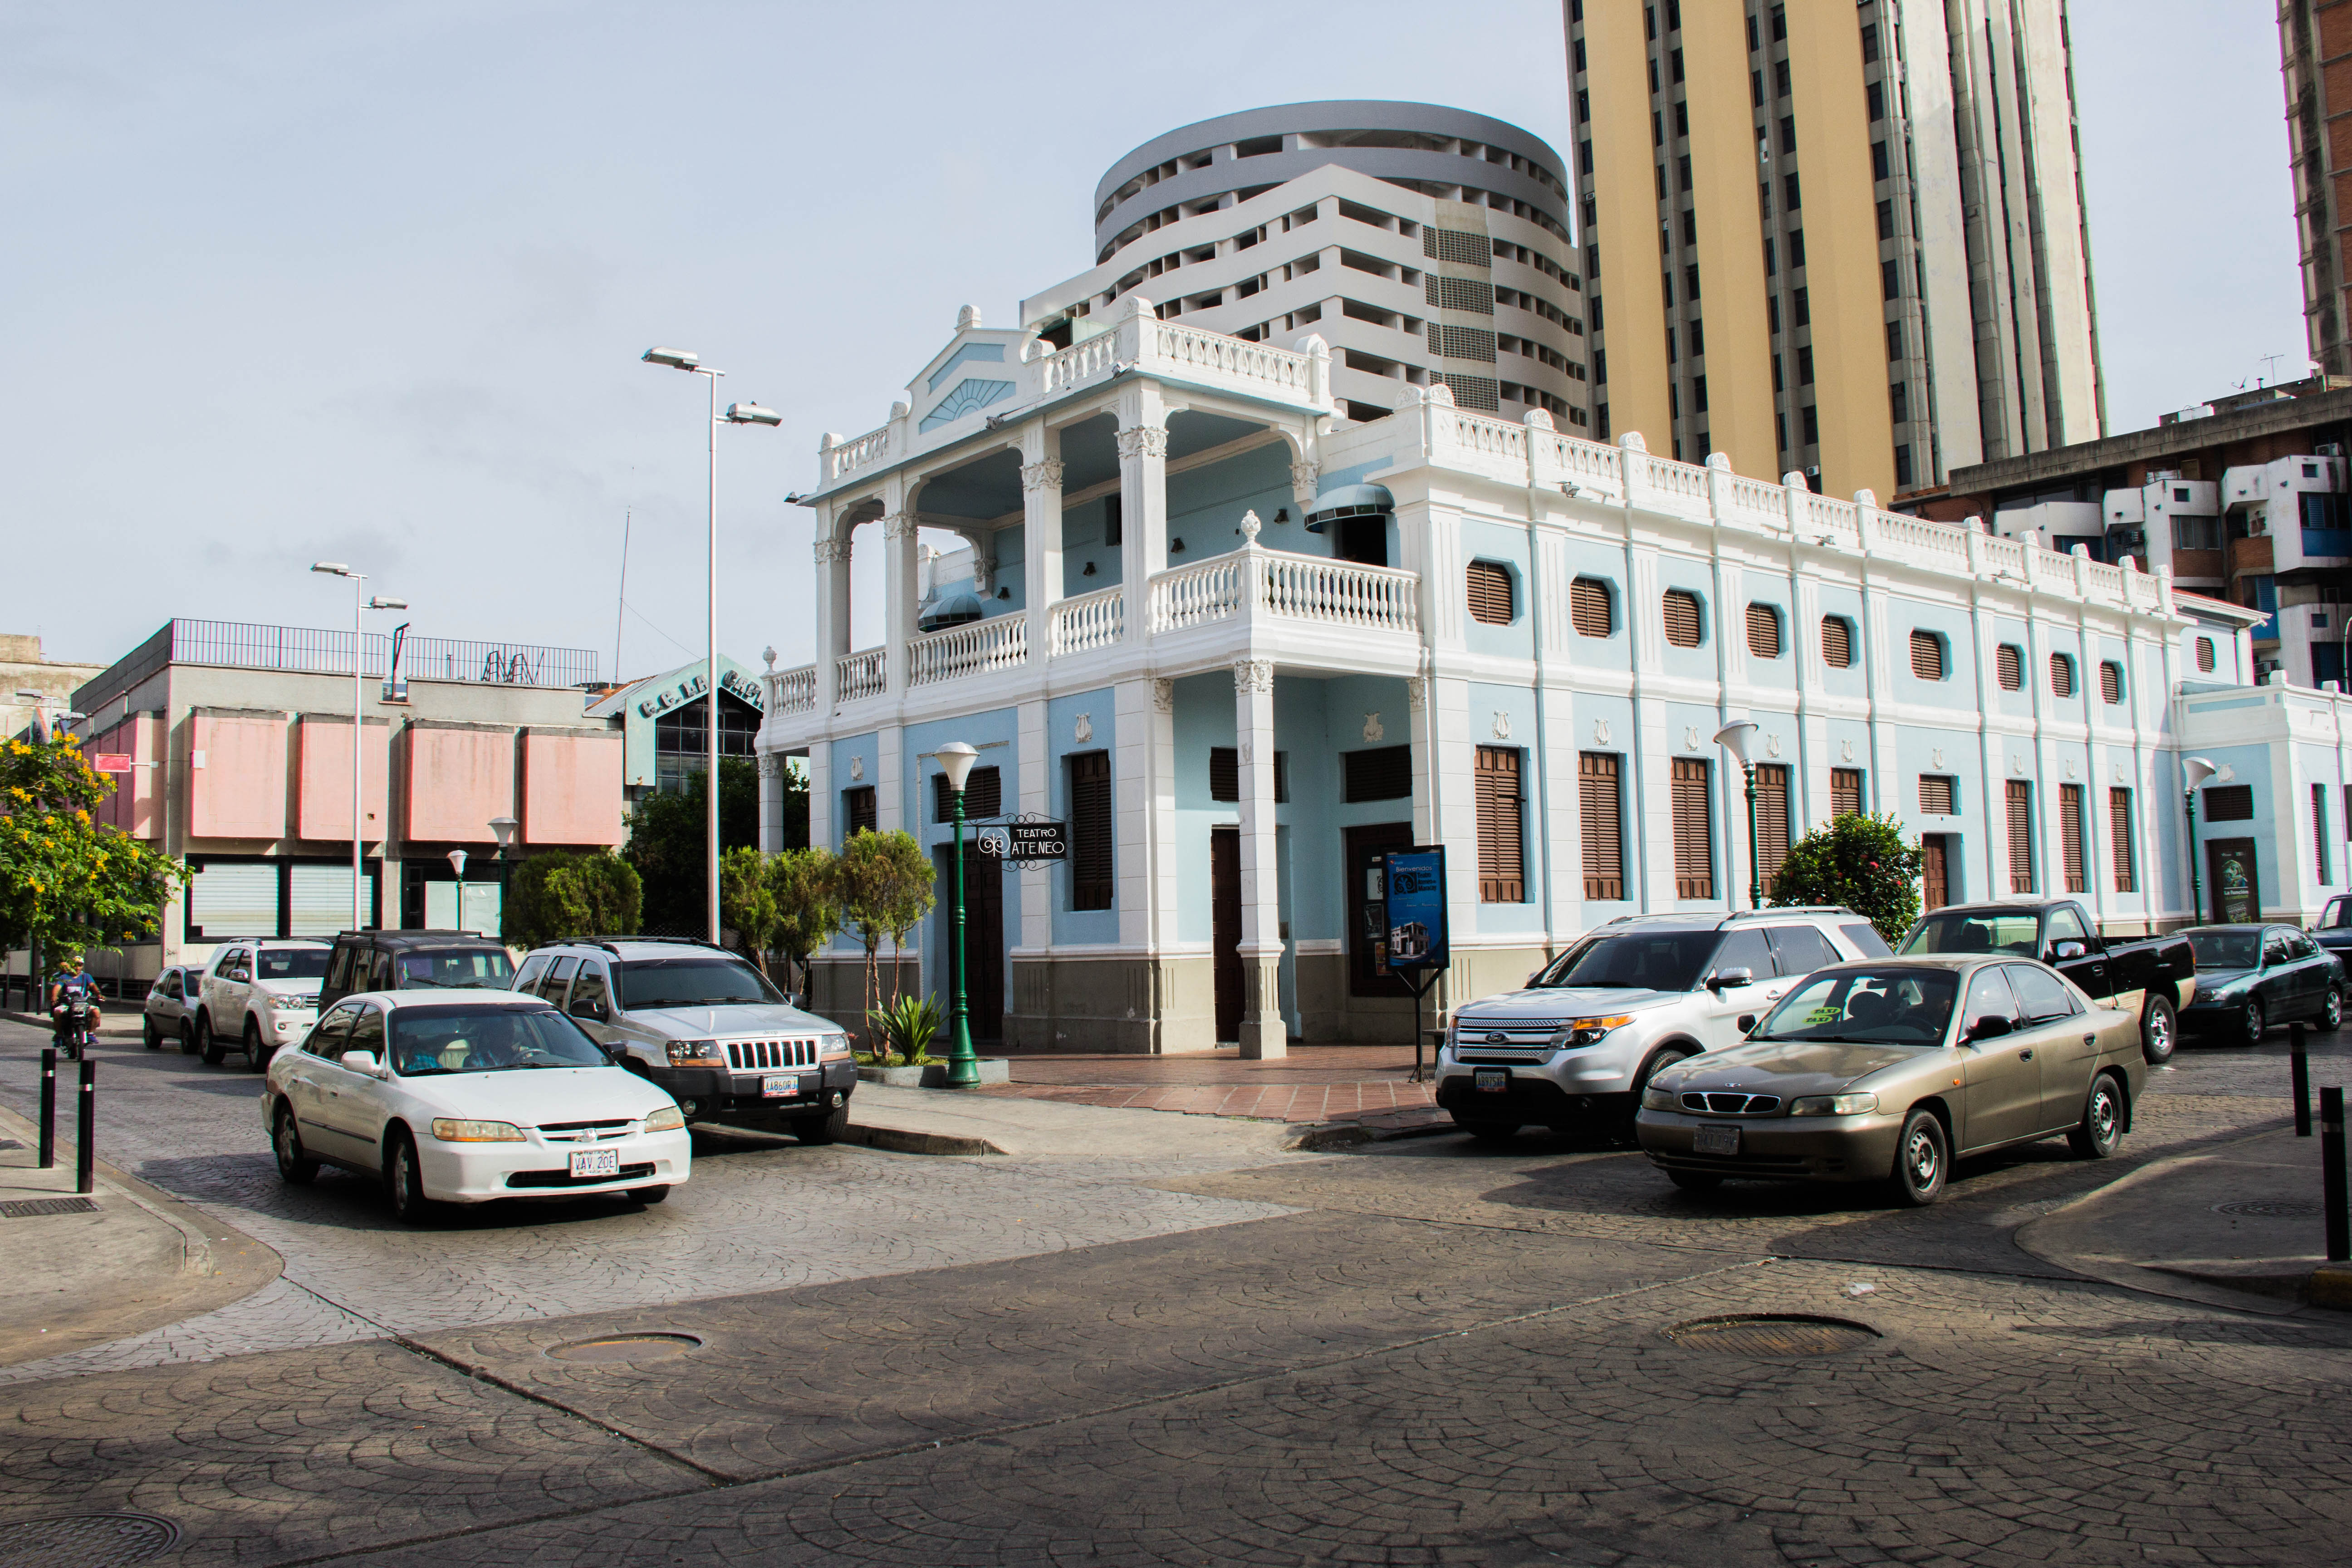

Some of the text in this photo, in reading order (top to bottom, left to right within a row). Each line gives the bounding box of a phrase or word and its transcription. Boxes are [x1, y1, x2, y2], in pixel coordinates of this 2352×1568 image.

[678, 675, 708, 700] LA
[721, 670, 764, 708] CAPI
[1016, 828, 1056, 838] TEATRO
[1012, 841, 1064, 855] ATENEO
[575, 1157, 592, 1170] VAV
